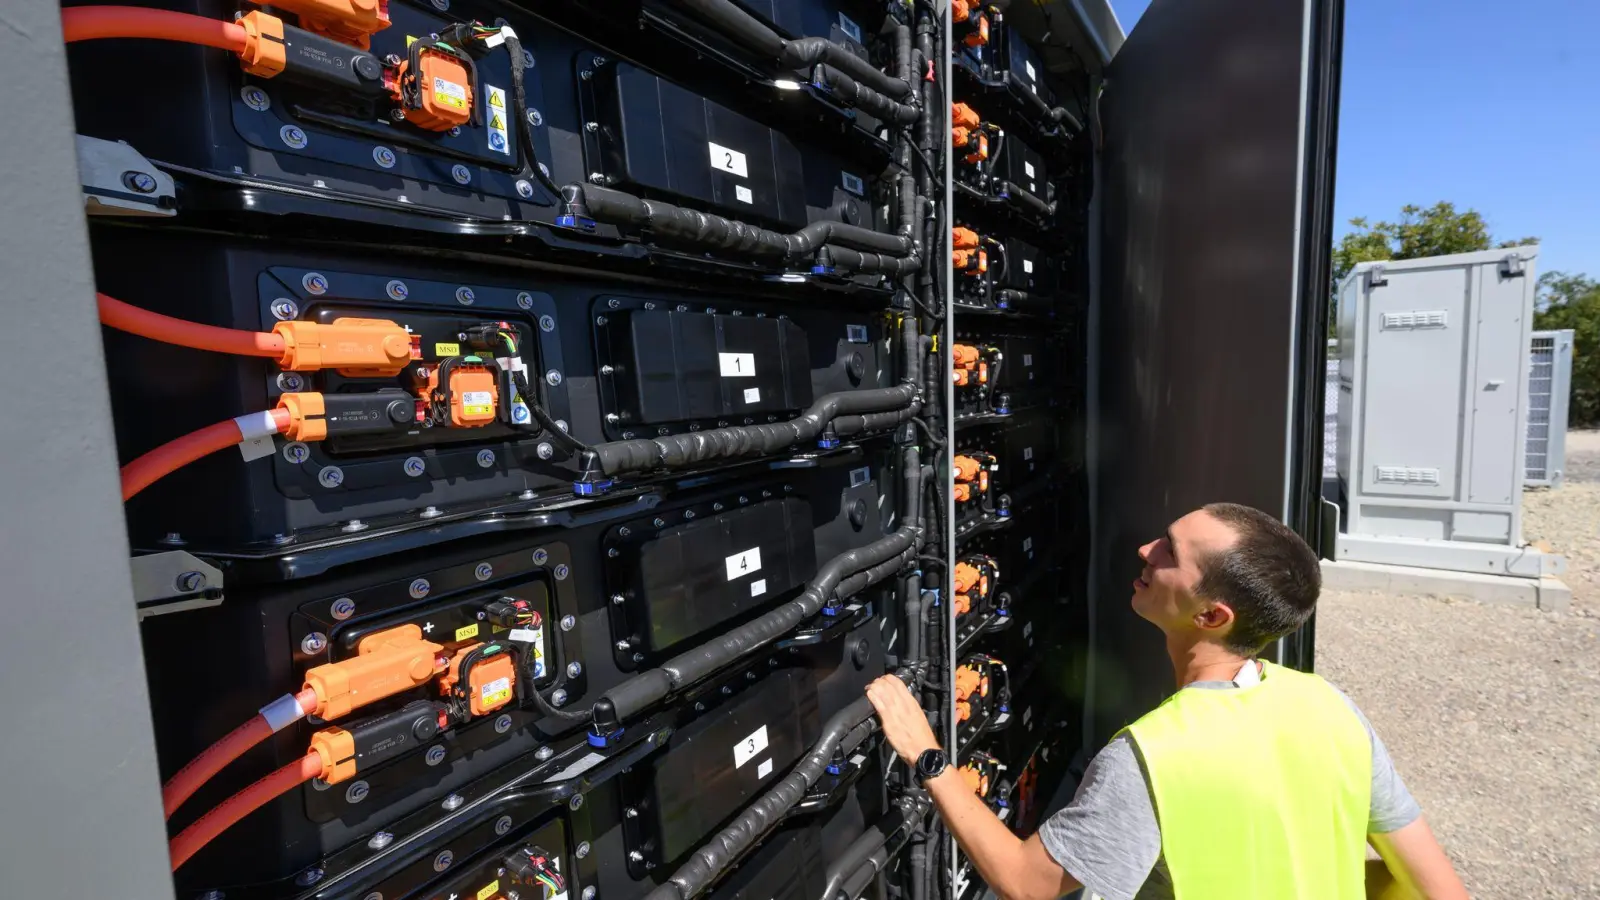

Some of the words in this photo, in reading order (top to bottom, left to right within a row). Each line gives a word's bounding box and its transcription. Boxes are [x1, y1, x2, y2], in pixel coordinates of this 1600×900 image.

[724, 152, 734, 169] 2
[439, 346, 458, 354] MSD
[734, 357, 742, 373] 1
[740, 555, 748, 571] 4
[459, 627, 476, 638] MSD
[747, 738, 756, 754] 3
